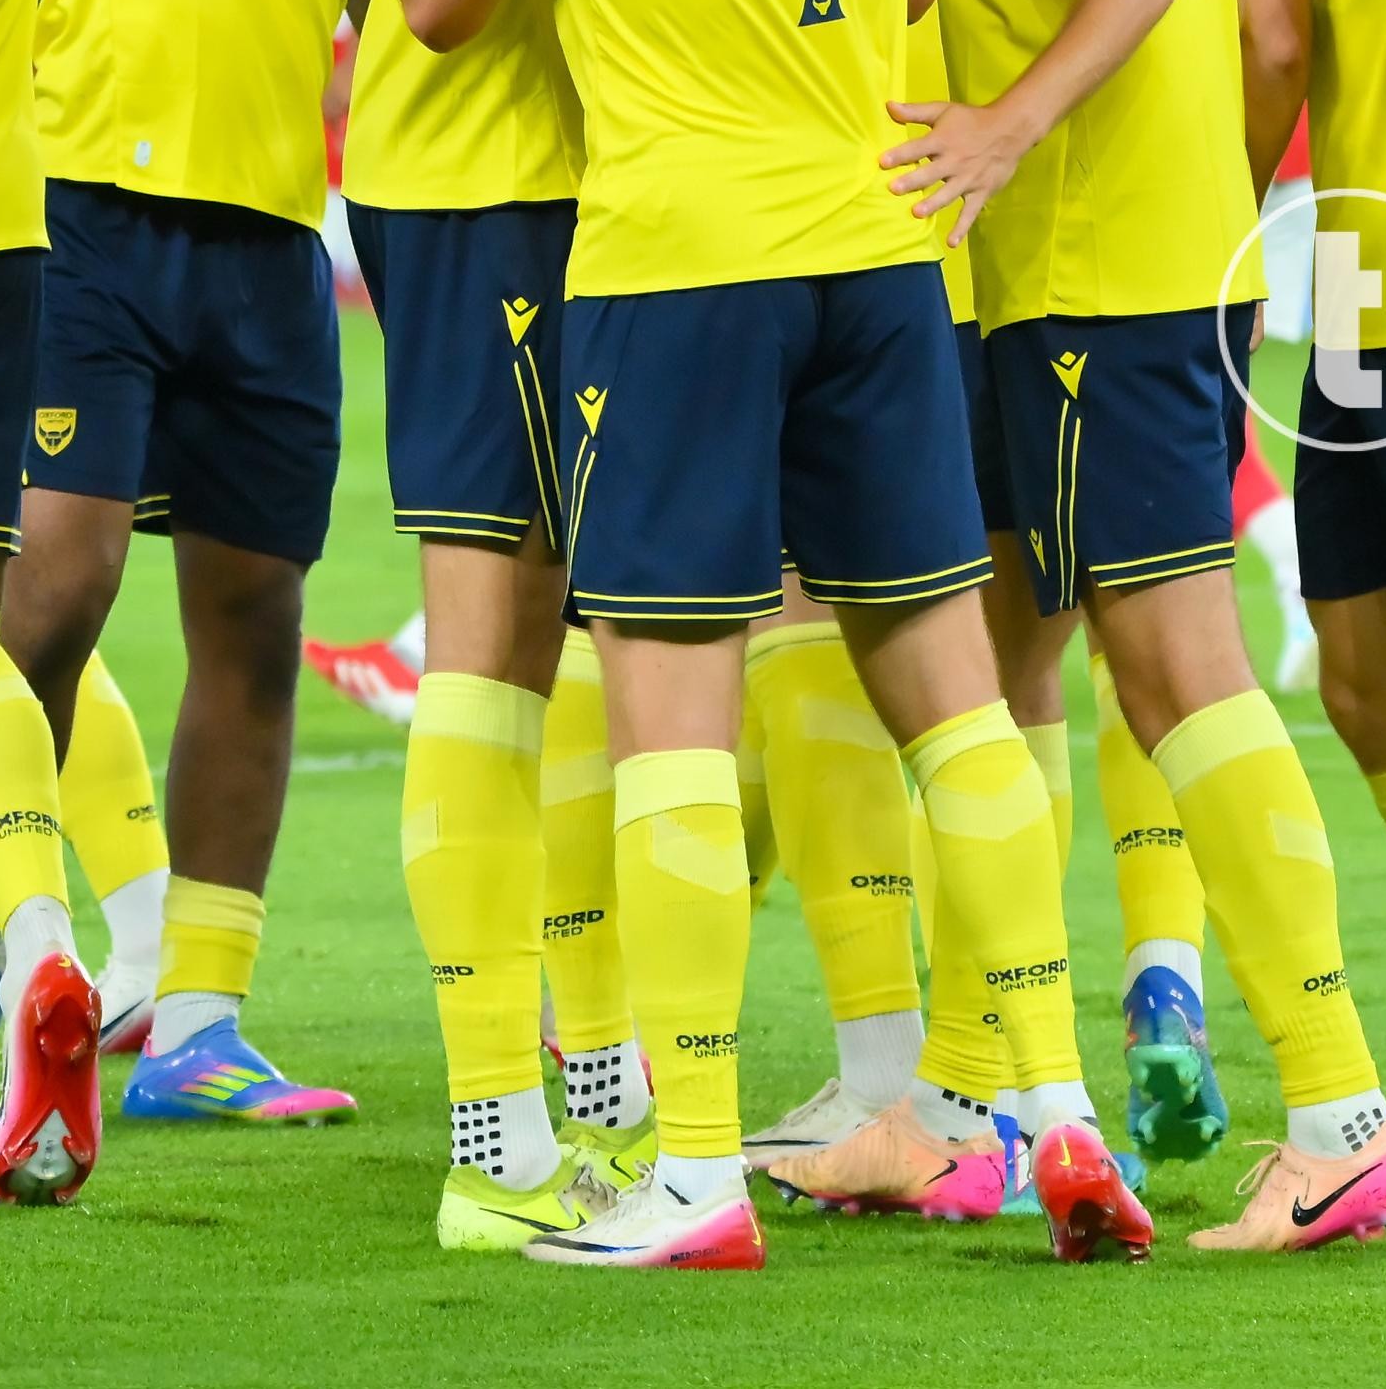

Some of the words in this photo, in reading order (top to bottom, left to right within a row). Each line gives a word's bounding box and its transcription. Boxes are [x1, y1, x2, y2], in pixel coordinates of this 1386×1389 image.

[430, 964, 475, 976] ORD
[985, 957, 1068, 986] OXFORD
[1000, 974, 1059, 993] UNITED
